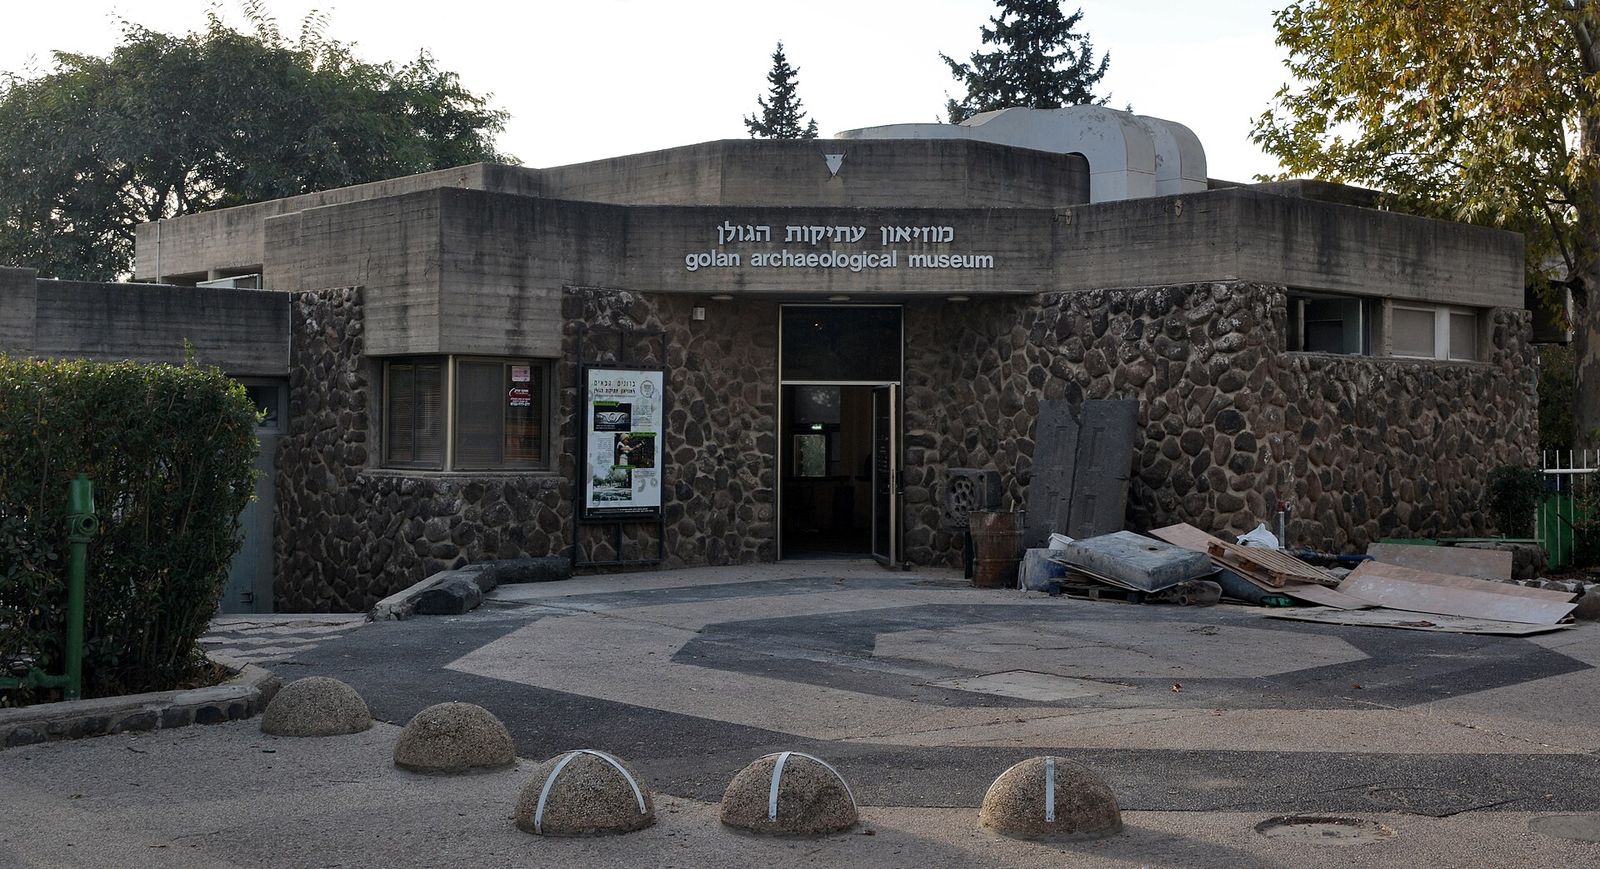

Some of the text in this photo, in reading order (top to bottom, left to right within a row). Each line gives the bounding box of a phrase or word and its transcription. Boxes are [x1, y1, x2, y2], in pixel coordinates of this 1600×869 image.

[717, 221, 954, 245] מוזיאון עתיקות הגולן
[685, 250, 994, 272] golan archaeological museum
